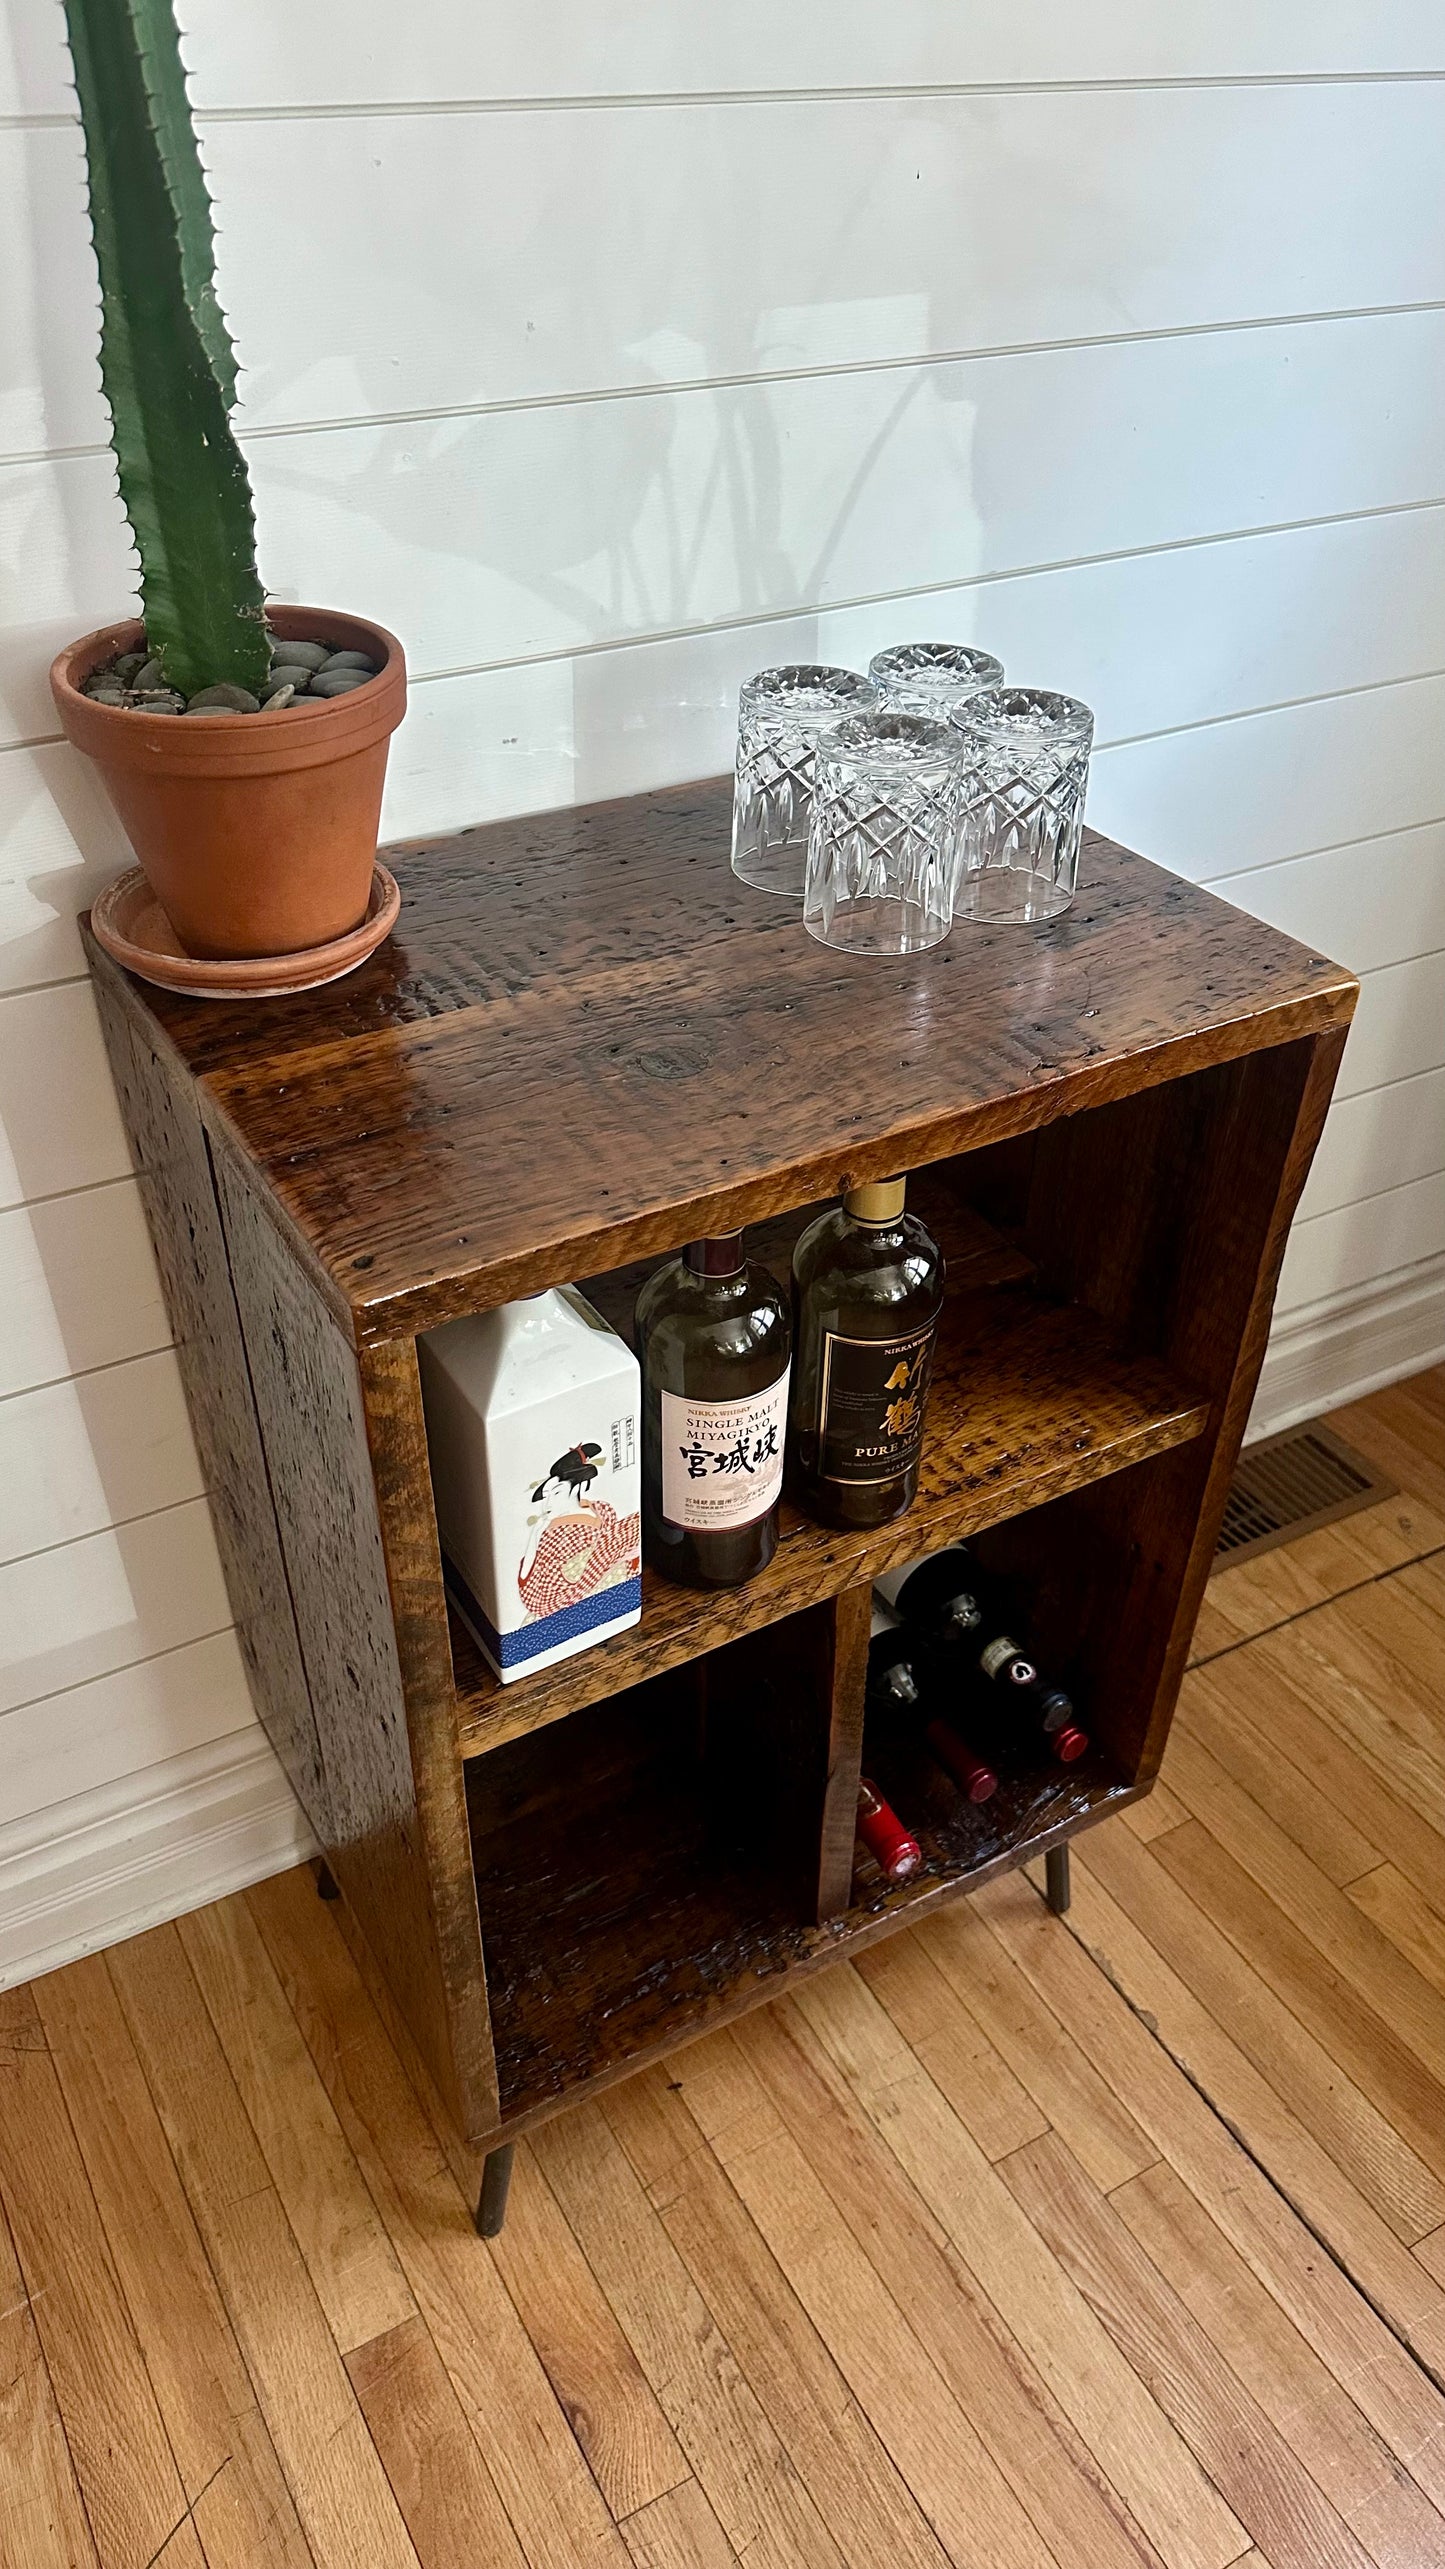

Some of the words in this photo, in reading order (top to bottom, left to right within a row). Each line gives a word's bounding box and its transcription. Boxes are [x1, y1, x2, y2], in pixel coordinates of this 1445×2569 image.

[884, 1343, 912, 1356] NIKKA
[686, 1417, 744, 1429] SINGLE
[748, 1398, 779, 1423] MALT
[688, 1408, 717, 1417] NIKKA
[719, 1405, 752, 1416] WHISKY
[686, 1417, 770, 1441] MIYAGIKYO
[679, 1424, 780, 1479] 宮城峡
[854, 1442, 899, 1458] PURE
